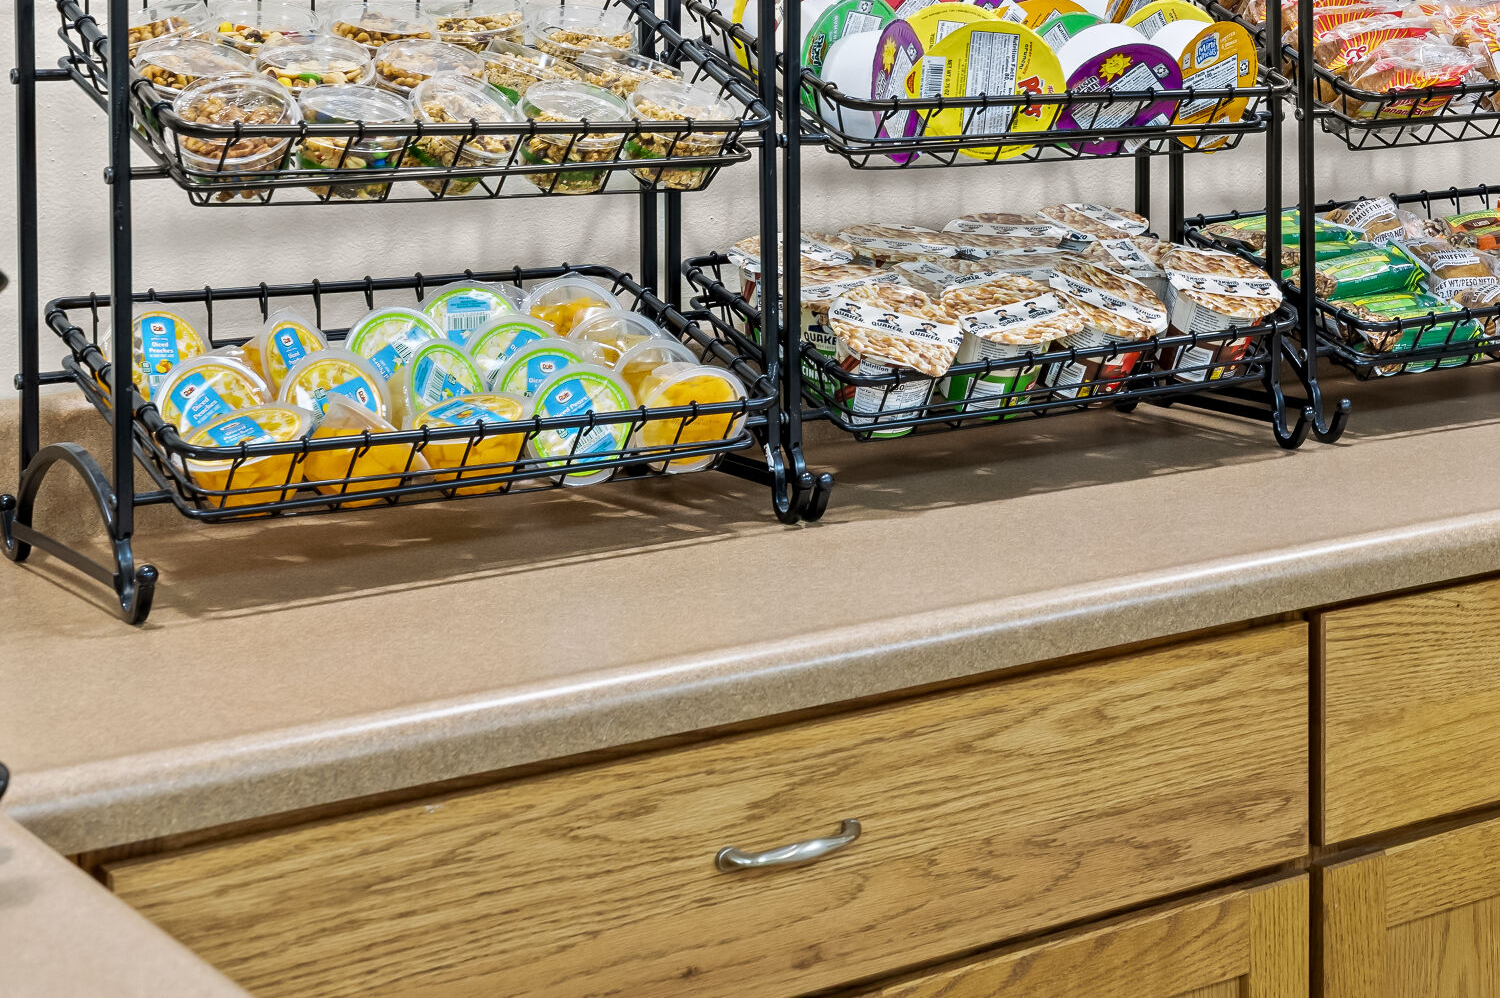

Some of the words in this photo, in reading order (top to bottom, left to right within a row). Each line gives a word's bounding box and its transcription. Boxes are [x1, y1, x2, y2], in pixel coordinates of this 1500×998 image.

[1011, 35, 1019, 62] Nutrition
[1197, 41, 1217, 55] Mini
[1196, 48, 1218, 65] Wheats
[1017, 75, 1043, 118] POS
[1345, 201, 1371, 224] BANANA
[1355, 202, 1382, 222] MUFFIN
[955, 274, 983, 284] QUAKER
[1064, 277, 1093, 293] QUAKER
[1211, 278, 1240, 287] QUAKER
[1435, 281, 1447, 292] NET
[1478, 277, 1495, 286] NETO
[1099, 293, 1127, 307] QUAKER
[834, 309, 866, 324] QUAKER
[1029, 309, 1056, 319] QUAKER
[1131, 305, 1161, 319] QUAKER
[871, 321, 903, 334] QUAKER
[999, 317, 1027, 327] QUAKER
[909, 330, 942, 342] QUAKER
[861, 359, 889, 372] Nutrition
[183, 386, 196, 397] Dole
[357, 390, 366, 403] Dole
[558, 391, 570, 401] Dole
[191, 397, 210, 413] Diced
[192, 399, 218, 420] Peaches
